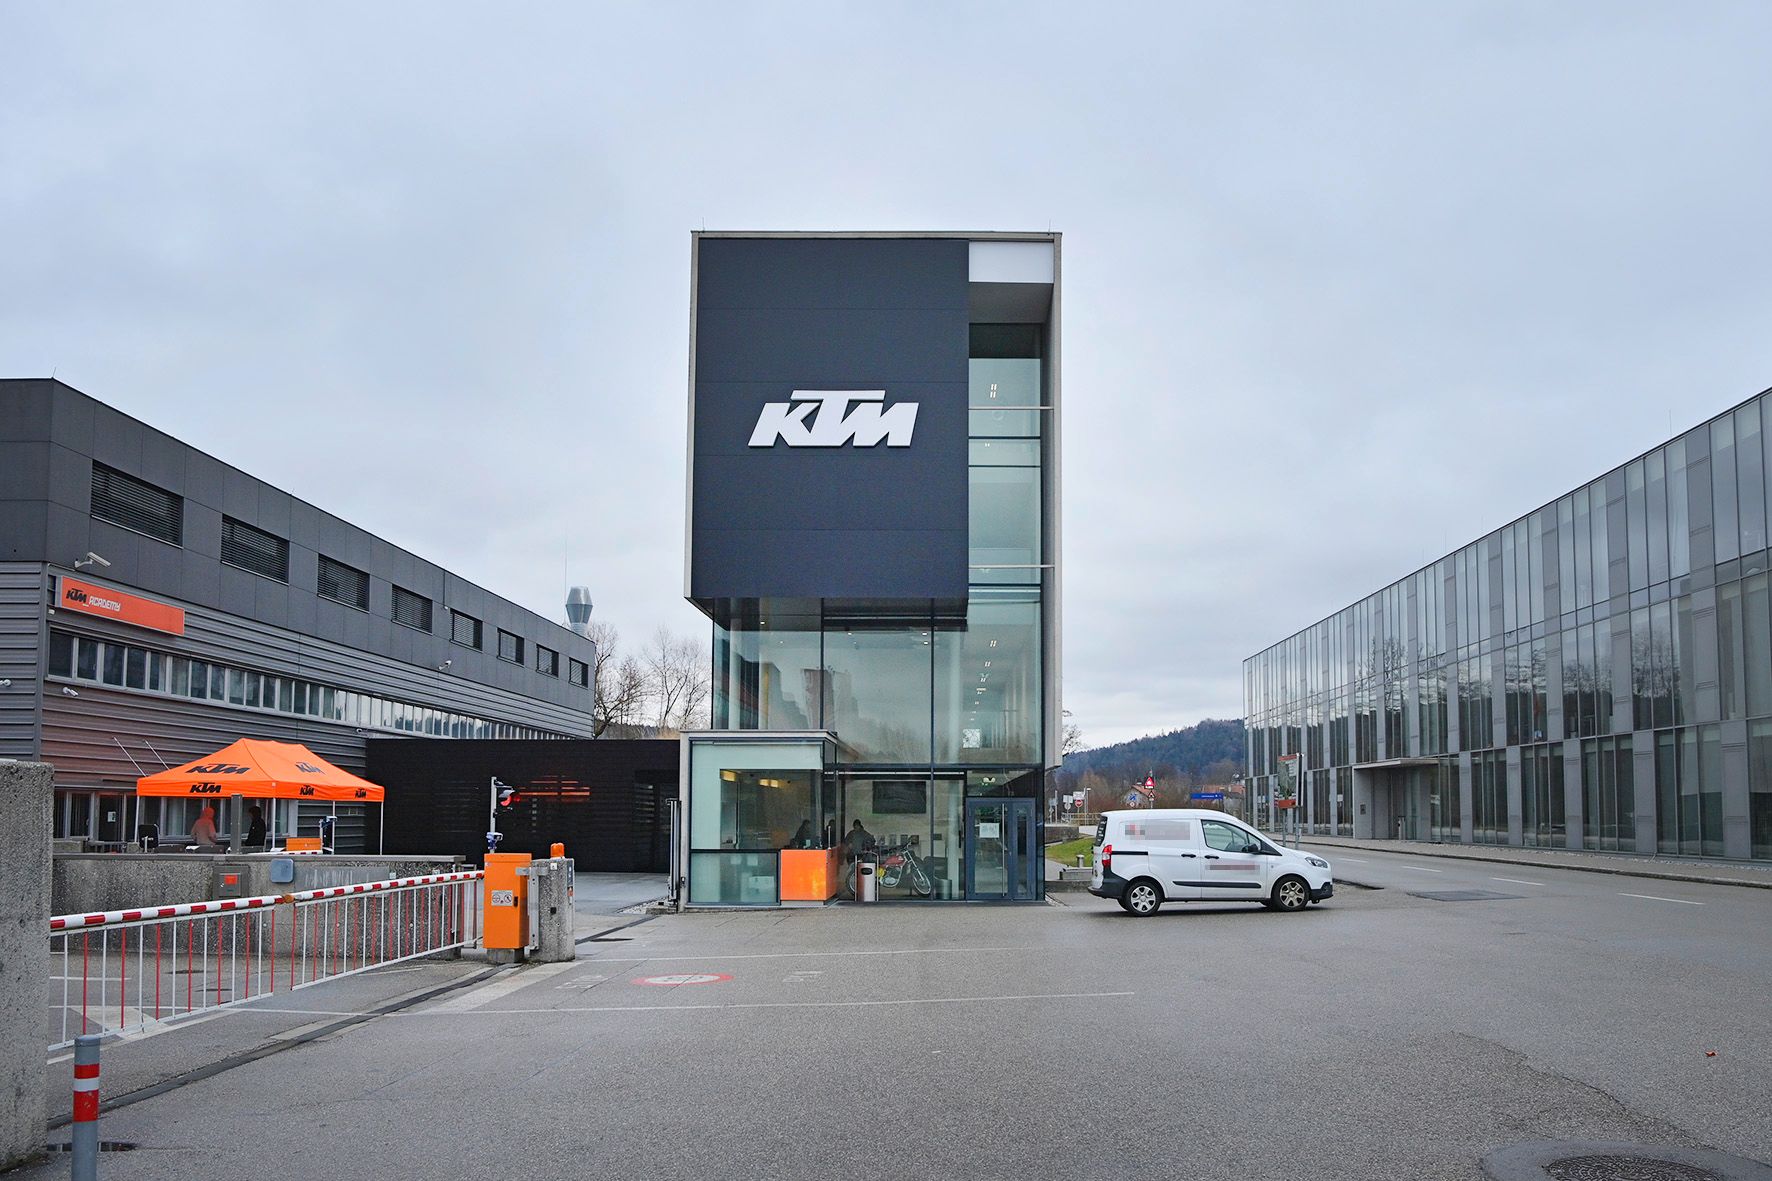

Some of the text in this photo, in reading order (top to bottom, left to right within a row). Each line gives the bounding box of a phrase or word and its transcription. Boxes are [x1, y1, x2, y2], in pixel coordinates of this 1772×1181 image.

[748, 390, 919, 447] KTM
[66, 588, 87, 603] KTM
[185, 763, 251, 775] KTM
[190, 782, 221, 793] KTM
[300, 785, 315, 796] KTM
[355, 788, 367, 798] KTM
